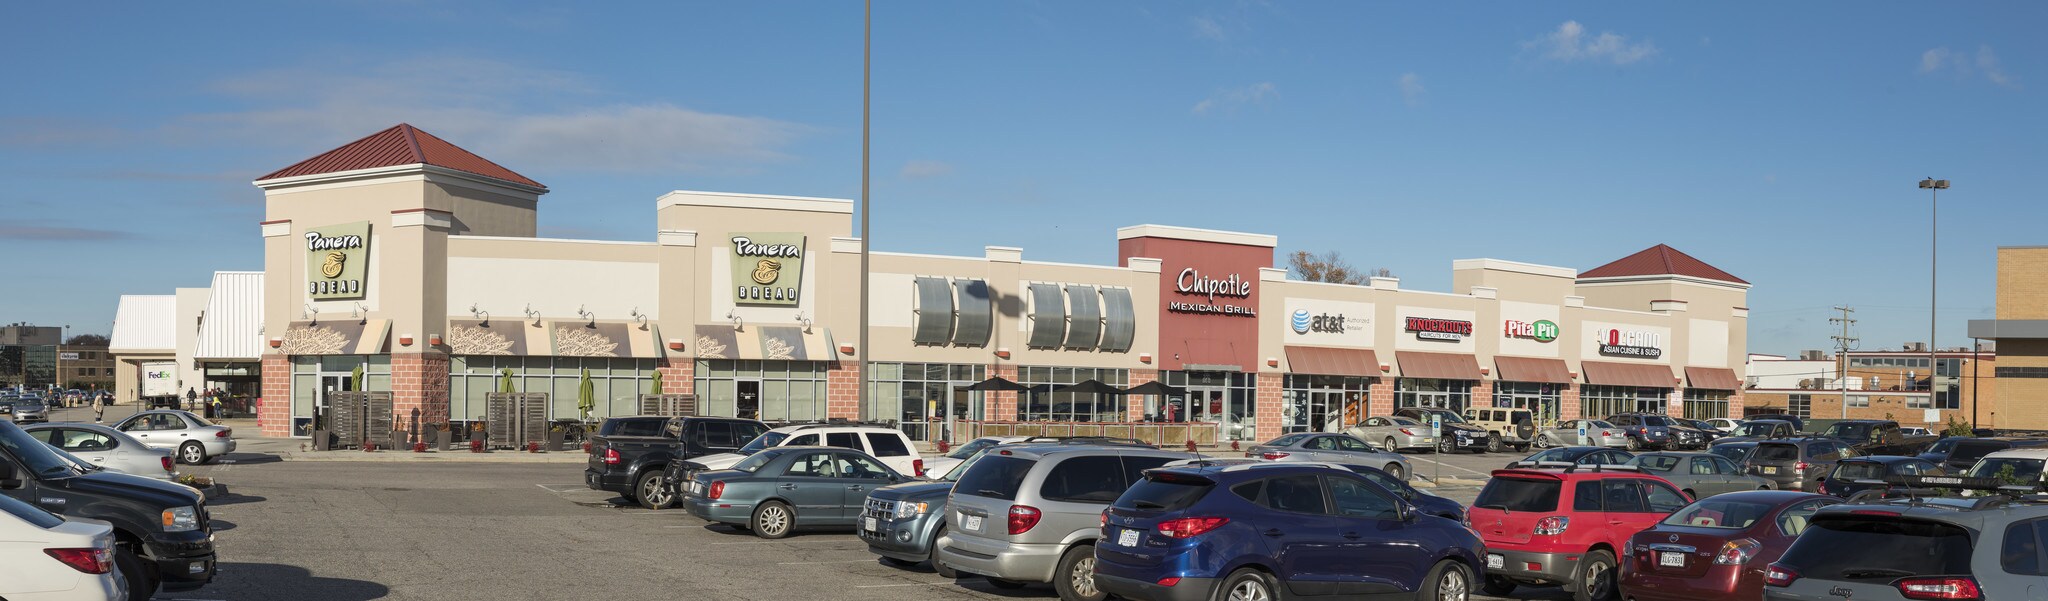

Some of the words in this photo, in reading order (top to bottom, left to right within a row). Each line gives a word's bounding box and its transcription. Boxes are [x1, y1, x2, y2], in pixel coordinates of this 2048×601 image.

[305, 231, 361, 250] Panera
[732, 236, 799, 257] Panera
[310, 281, 358, 294] BREAD
[1177, 267, 1250, 301] Chipotle
[739, 286, 796, 300] BREAD
[1169, 301, 1220, 312] MEXICAN
[1225, 304, 1256, 315] GRILL
[1311, 312, 1345, 333] at&t
[1408, 317, 1473, 334] KNOCKOUTS
[1506, 320, 1535, 337] Pita
[1537, 323, 1556, 338] Pit
[1599, 328, 1661, 349] VOLCANO
[1603, 345, 1619, 353] ASIAN
[1620, 346, 1640, 355] CUISINE
[1645, 348, 1660, 356] SUSHI
[148, 371, 170, 380] FedEx
